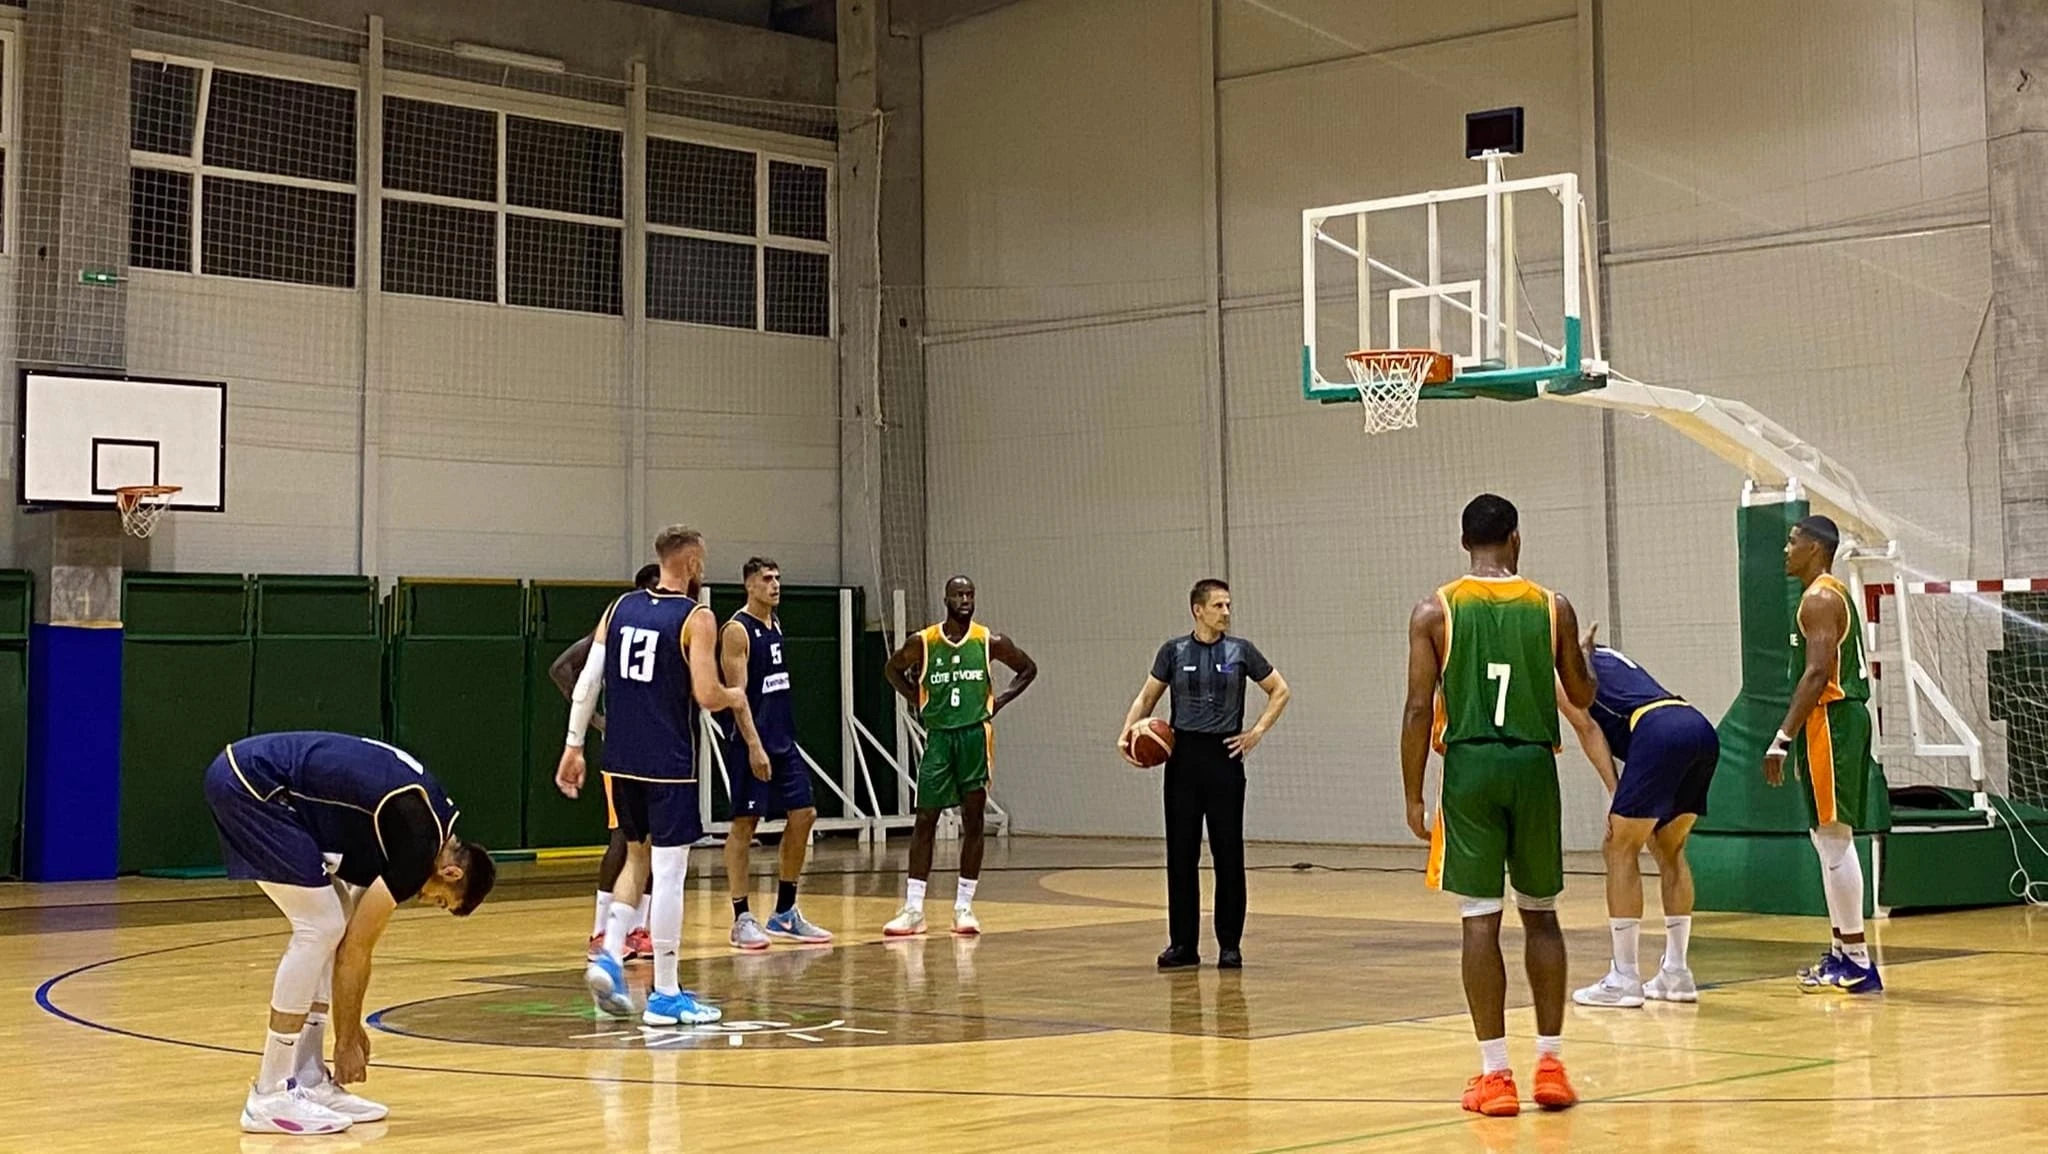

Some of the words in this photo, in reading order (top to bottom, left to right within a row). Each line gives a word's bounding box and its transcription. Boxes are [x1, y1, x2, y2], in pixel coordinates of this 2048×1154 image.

[620, 625, 660, 683] 13
[930, 671, 950, 685] CÔTE
[950, 687, 961, 707] 6
[1487, 662, 1511, 727] 7
